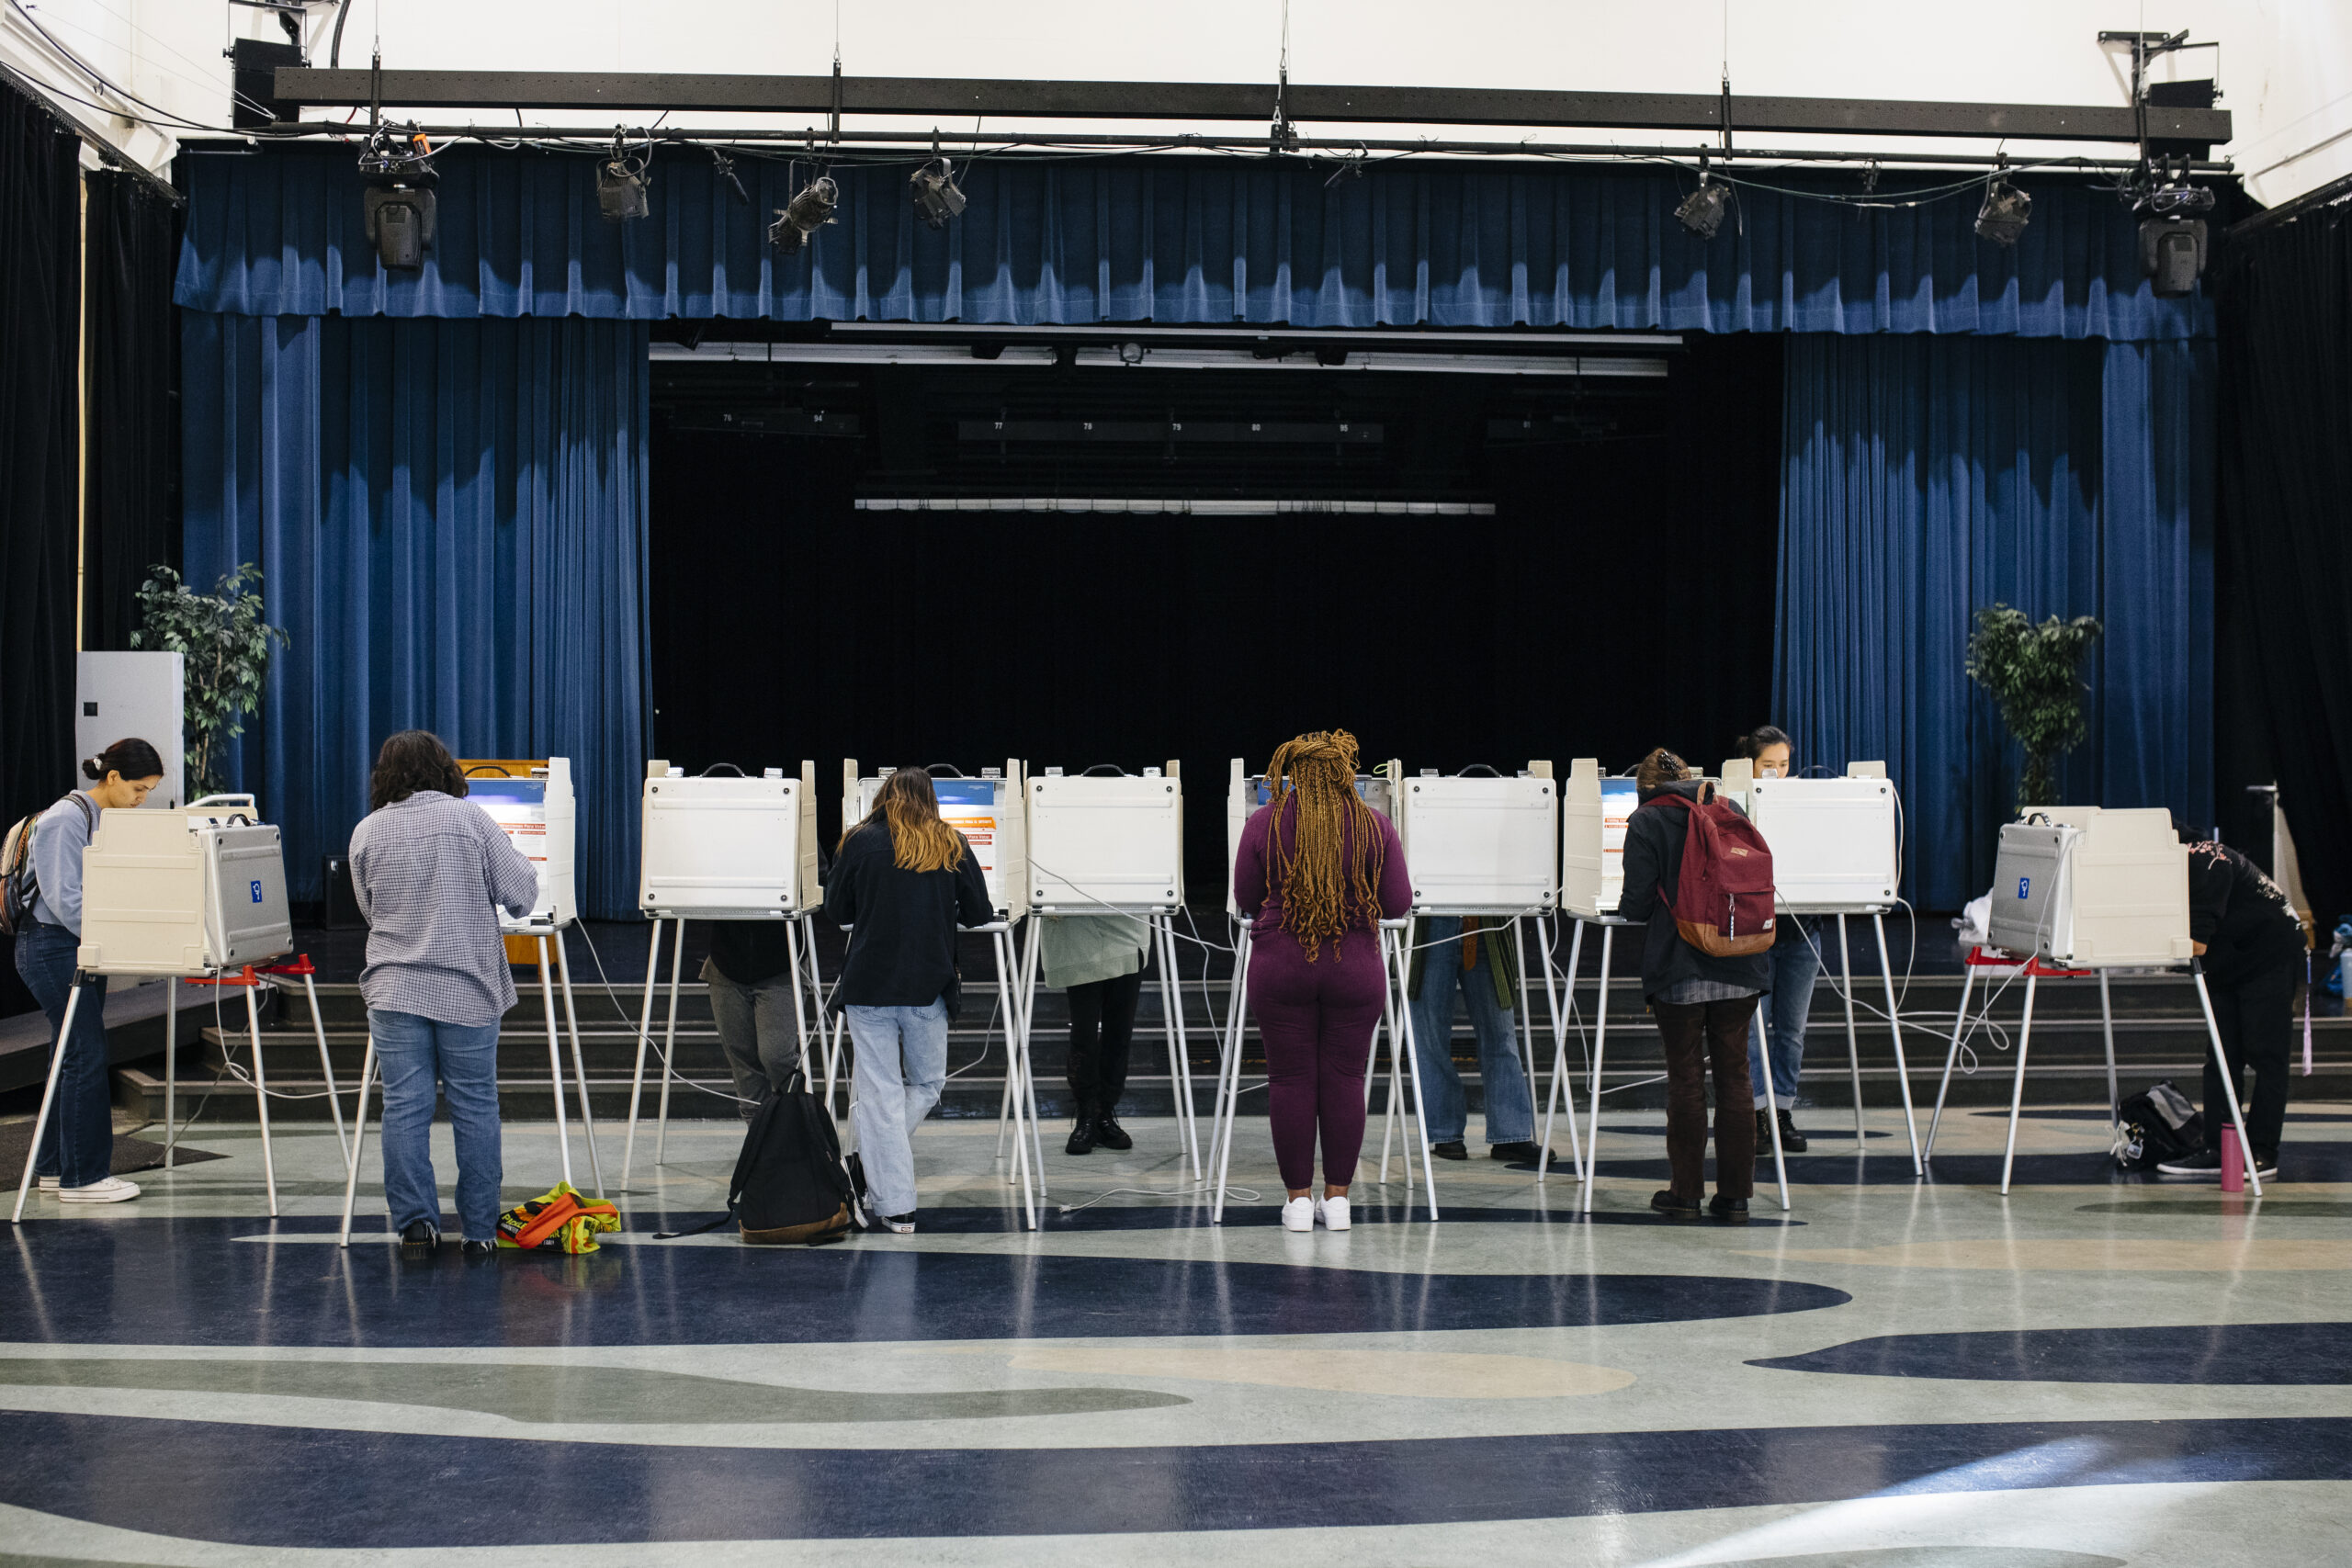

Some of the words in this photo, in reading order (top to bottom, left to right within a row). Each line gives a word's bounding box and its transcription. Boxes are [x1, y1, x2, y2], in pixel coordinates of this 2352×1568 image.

[814, 414, 823, 423] 94
[994, 422, 1003, 430] 77
[1083, 422, 1092, 430] 78
[1172, 423, 1182, 431] 79
[1251, 423, 1261, 432] 80
